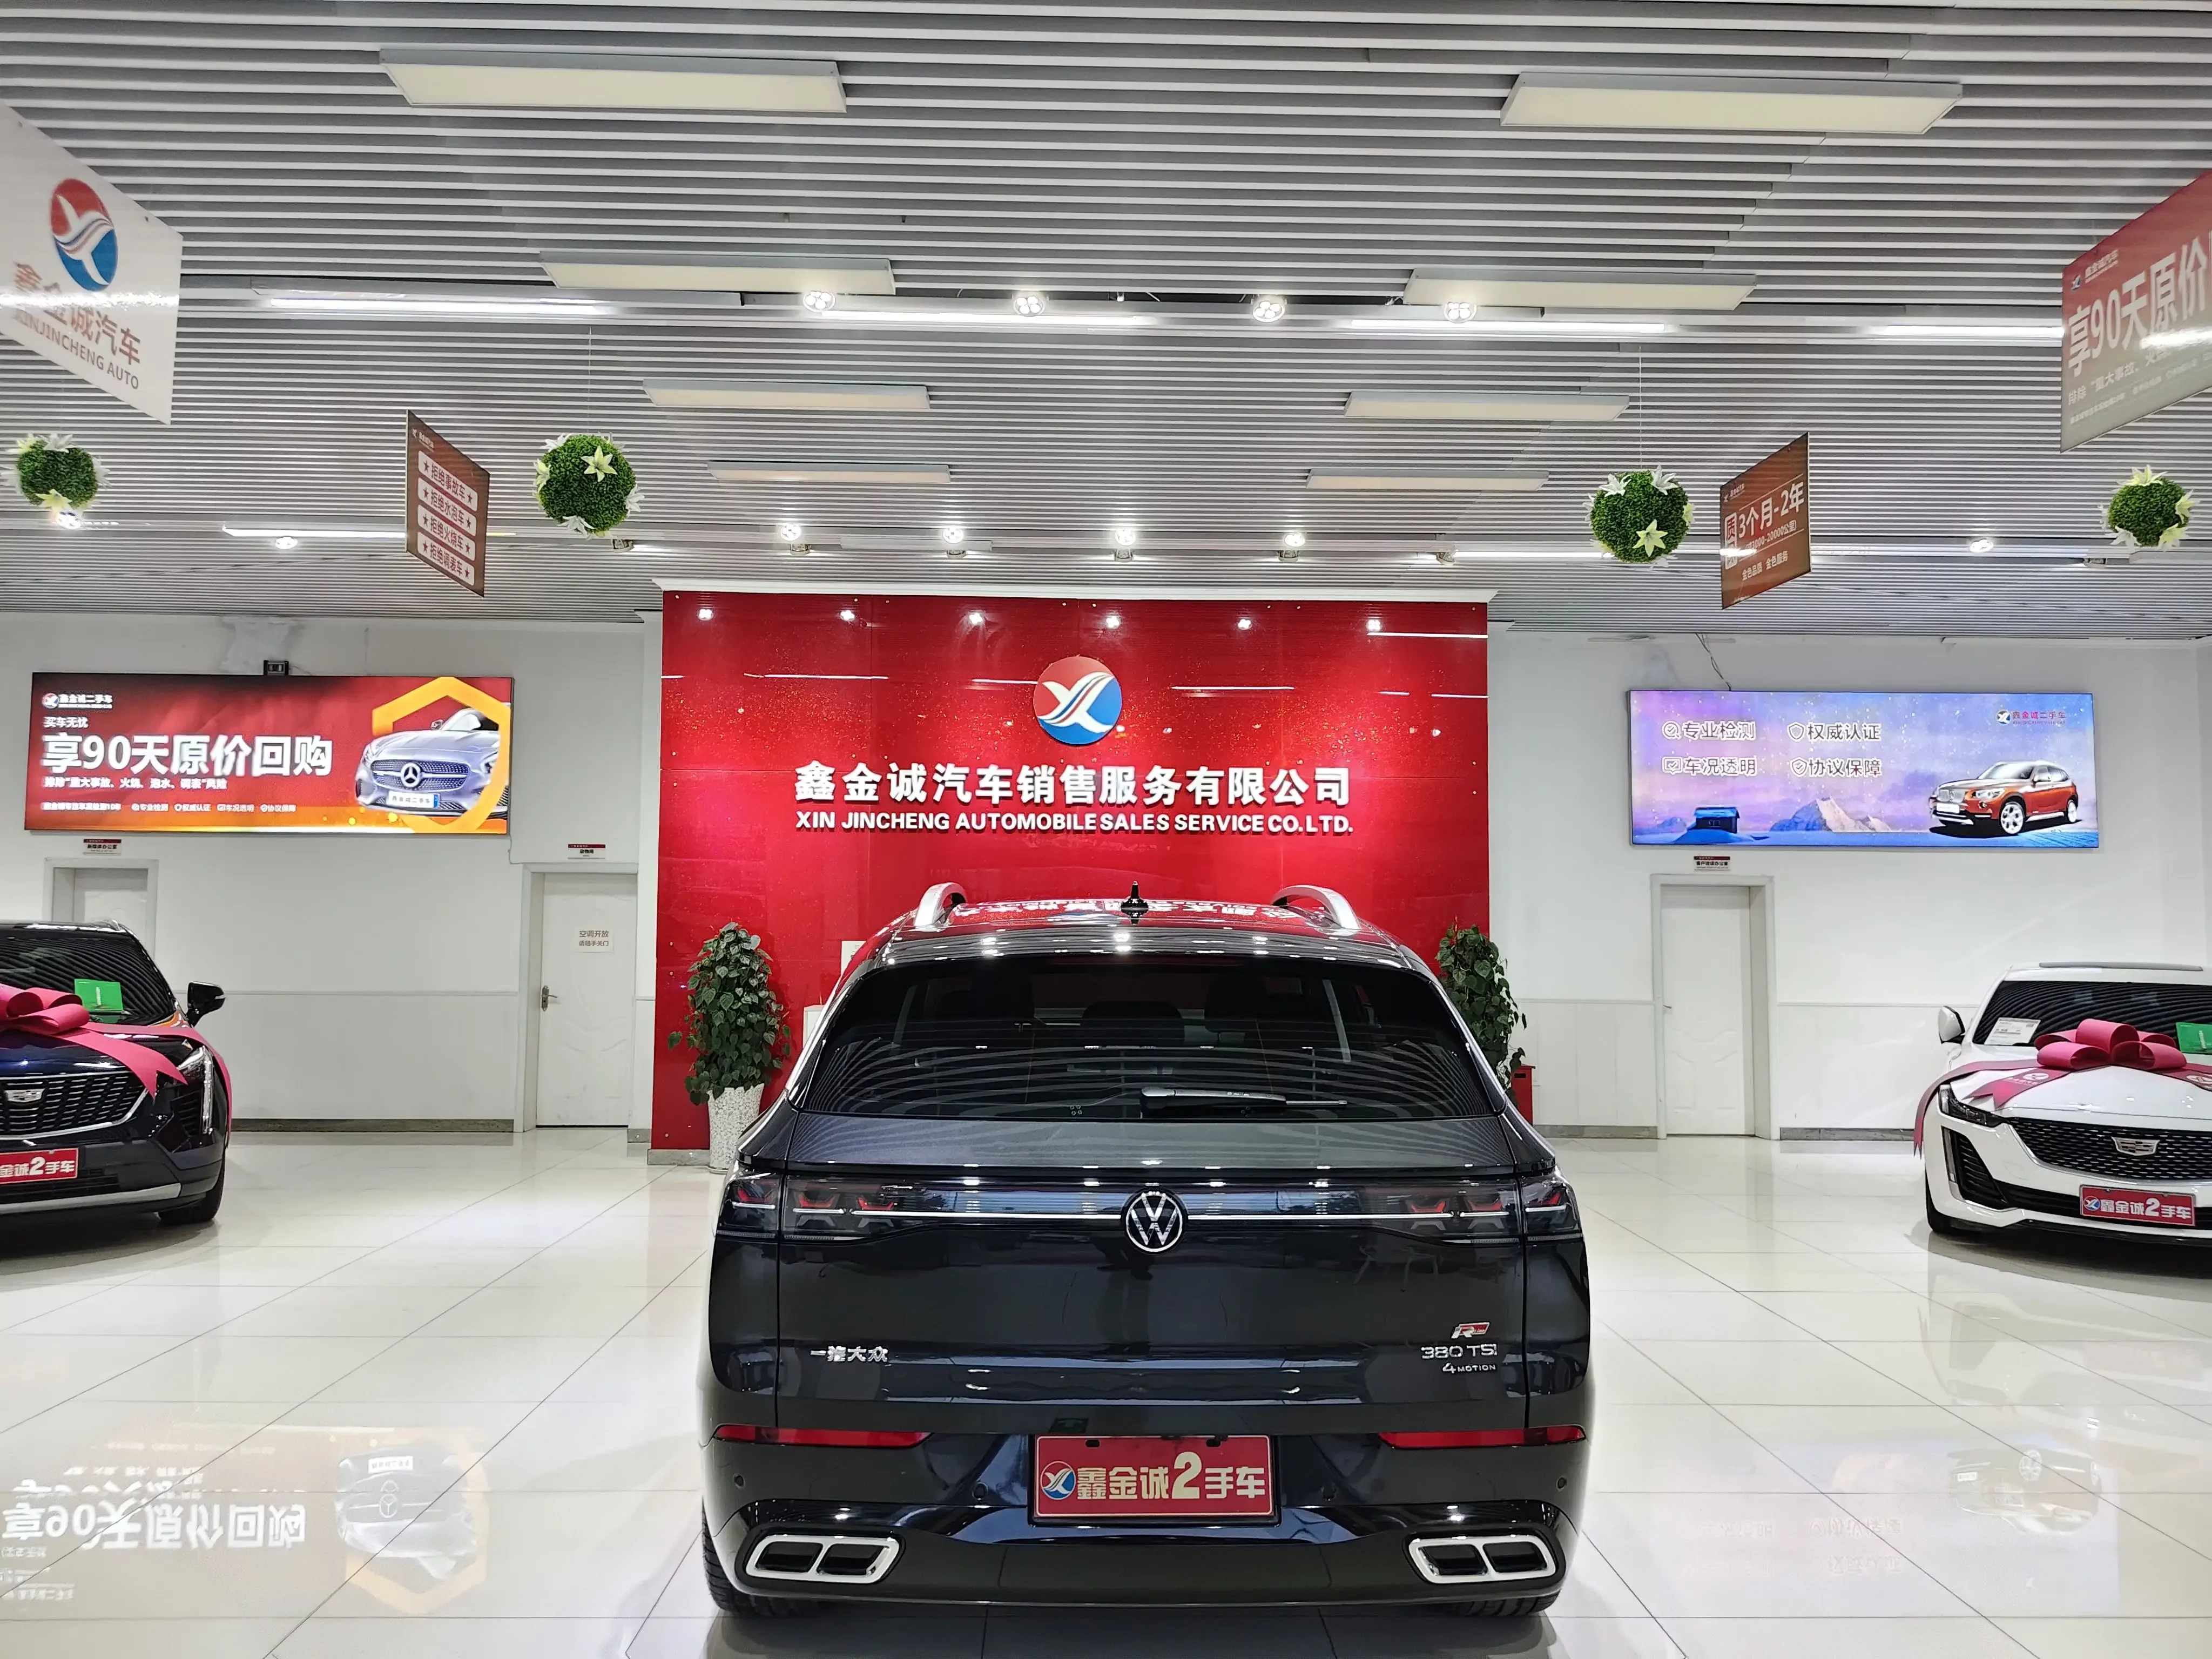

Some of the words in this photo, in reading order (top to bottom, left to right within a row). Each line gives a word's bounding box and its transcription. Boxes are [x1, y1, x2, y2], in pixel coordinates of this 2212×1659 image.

[2068, 231, 2212, 377] 享90天原价
[107, 362, 139, 389] AUTO
[431, 464, 465, 500] 拒绝事故车
[1738, 482, 1804, 538] 3个月-2年
[43, 717, 89, 728] 买车无忧
[1683, 721, 1756, 740] 专业检测
[1807, 722, 1881, 741] 权威认证
[42, 733, 332, 777] 享90天原价回购
[1683, 757, 1757, 776] 车况透明
[1809, 758, 1882, 778] 协议保障
[795, 760, 1349, 805] 鑫金诚汽车销售服务有限公司
[796, 811, 835, 828] XIN
[841, 812, 949, 830] JINCHENG
[955, 812, 1096, 831] AUTOMOBILE
[1100, 813, 1169, 831] SALES
[1174, 814, 1264, 832] SERVICE
[2100, 1198, 2191, 1219] 鑫金诚2手车
[1421, 1345, 1463, 1359] 380
[1442, 1363, 1496, 1373] 4MOTION
[1077, 1452, 1265, 1500] 鑫金诚2手车
